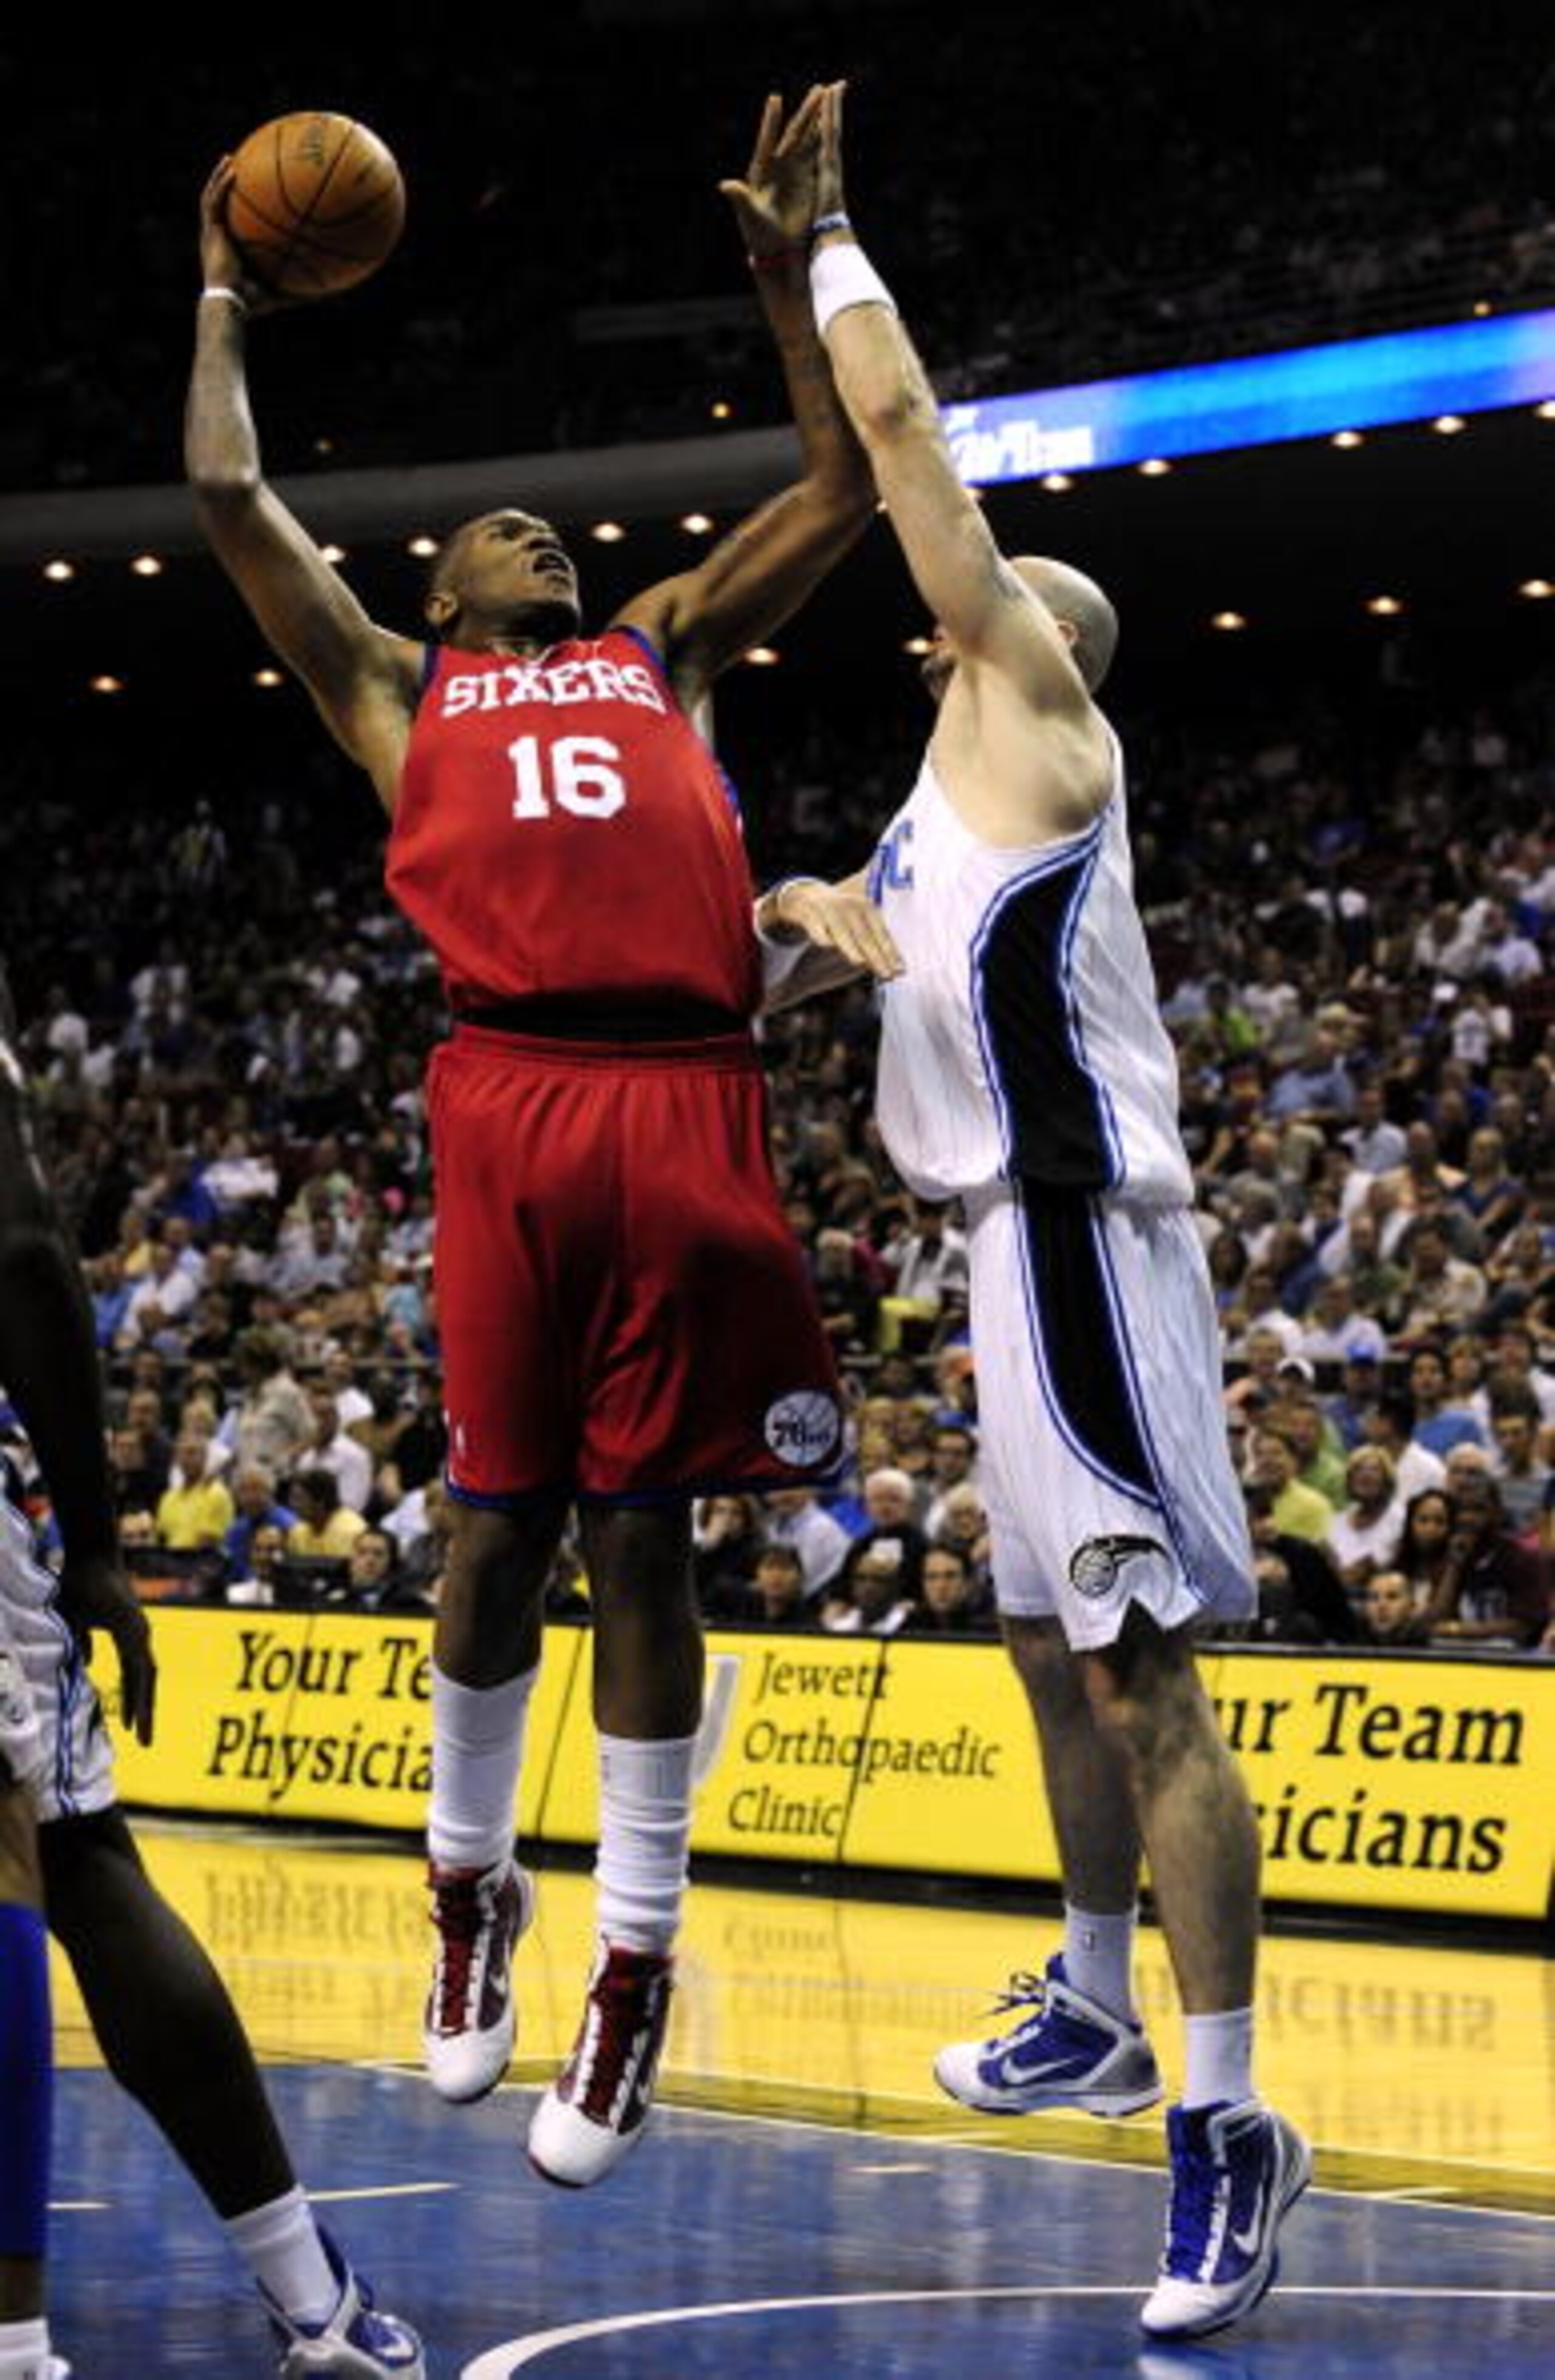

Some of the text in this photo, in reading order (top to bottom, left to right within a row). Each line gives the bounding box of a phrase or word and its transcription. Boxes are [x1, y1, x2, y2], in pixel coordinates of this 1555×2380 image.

[441, 660, 667, 718] SIXERS
[508, 735, 626, 820] 16
[236, 1631, 361, 1696] Your
[756, 1651, 892, 1706] Jewett
[743, 1717, 1001, 1784] Orthopaedic
[1314, 1683, 1524, 1765] Team
[728, 1785, 844, 1836] Clinic
[1256, 1784, 1507, 1874] icians
